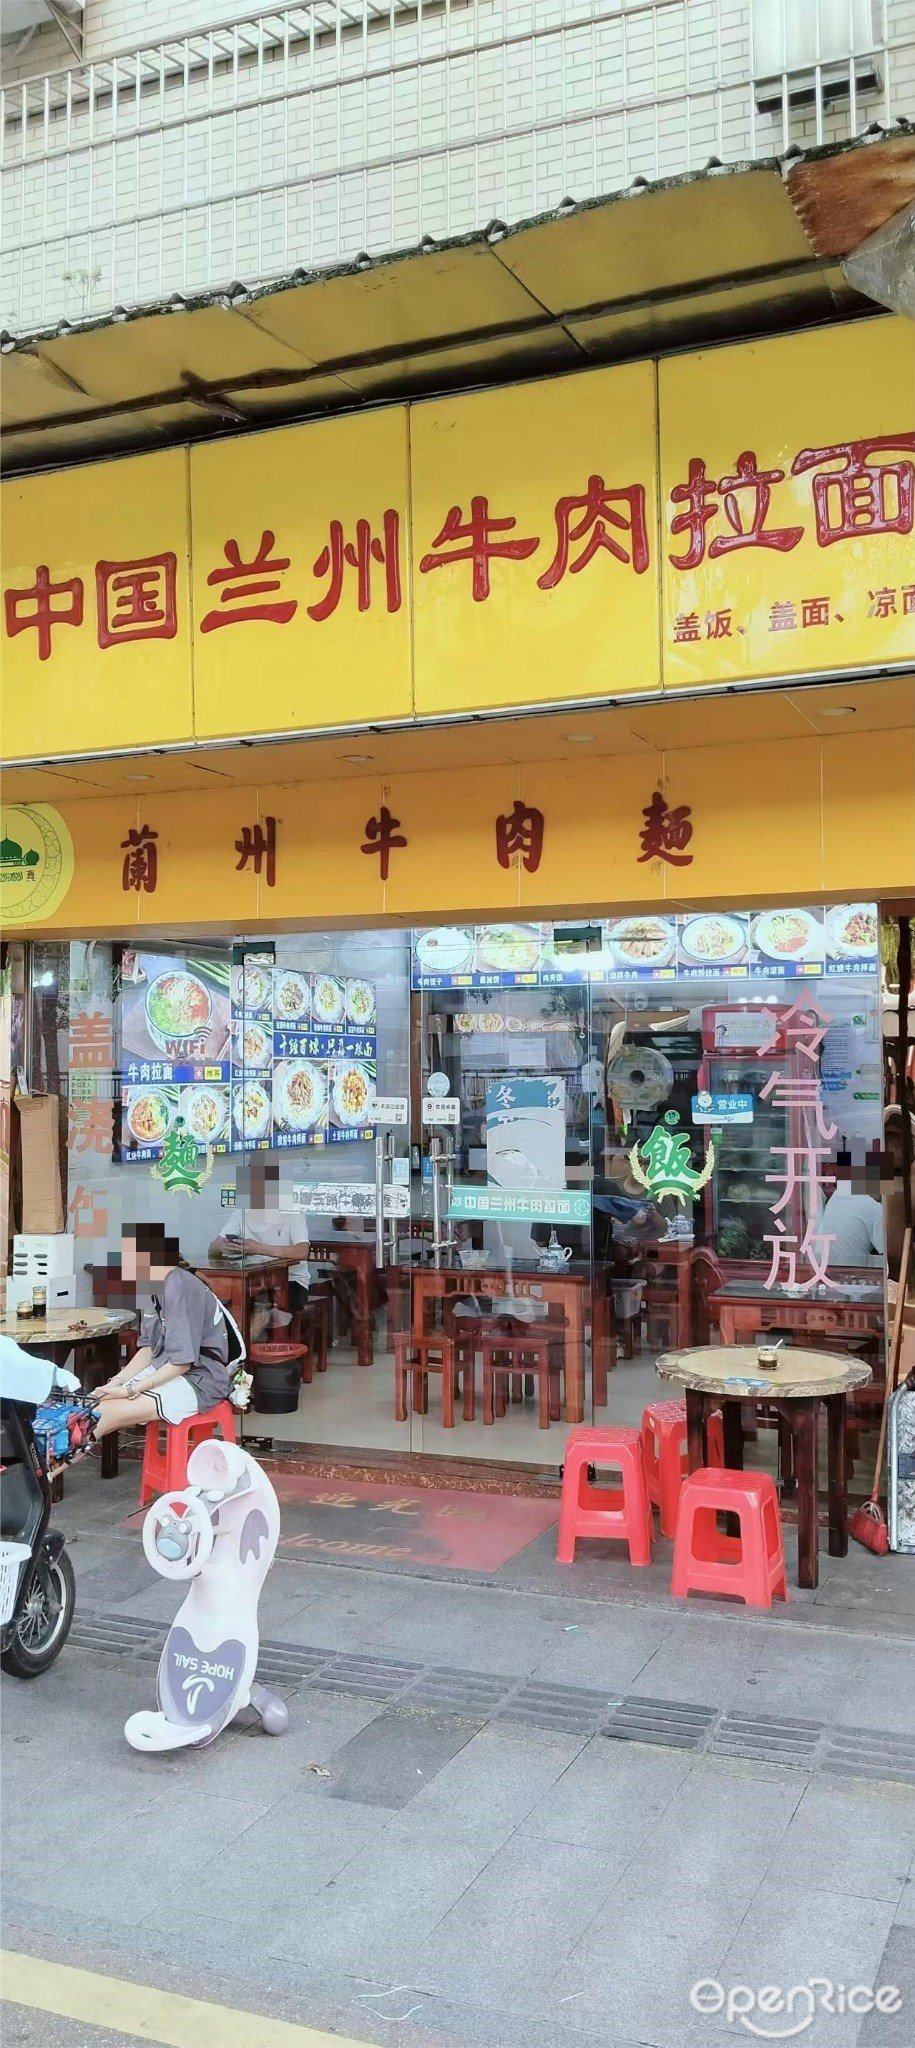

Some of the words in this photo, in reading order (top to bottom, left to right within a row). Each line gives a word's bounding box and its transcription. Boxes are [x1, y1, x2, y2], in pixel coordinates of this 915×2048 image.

[5, 432, 915, 660] 中国兰州牛肉拉面
[128, 1062, 173, 1081] 牛肉拉面
[717, 1099, 747, 1109] 营业中
[756, 988, 838, 1290] 冷气开放
[641, 1125, 701, 1180] 飯
[280, 1533, 411, 1557] lcome
[173, 1653, 199, 1670] SAIL
[200, 1660, 235, 1681] HOPE
